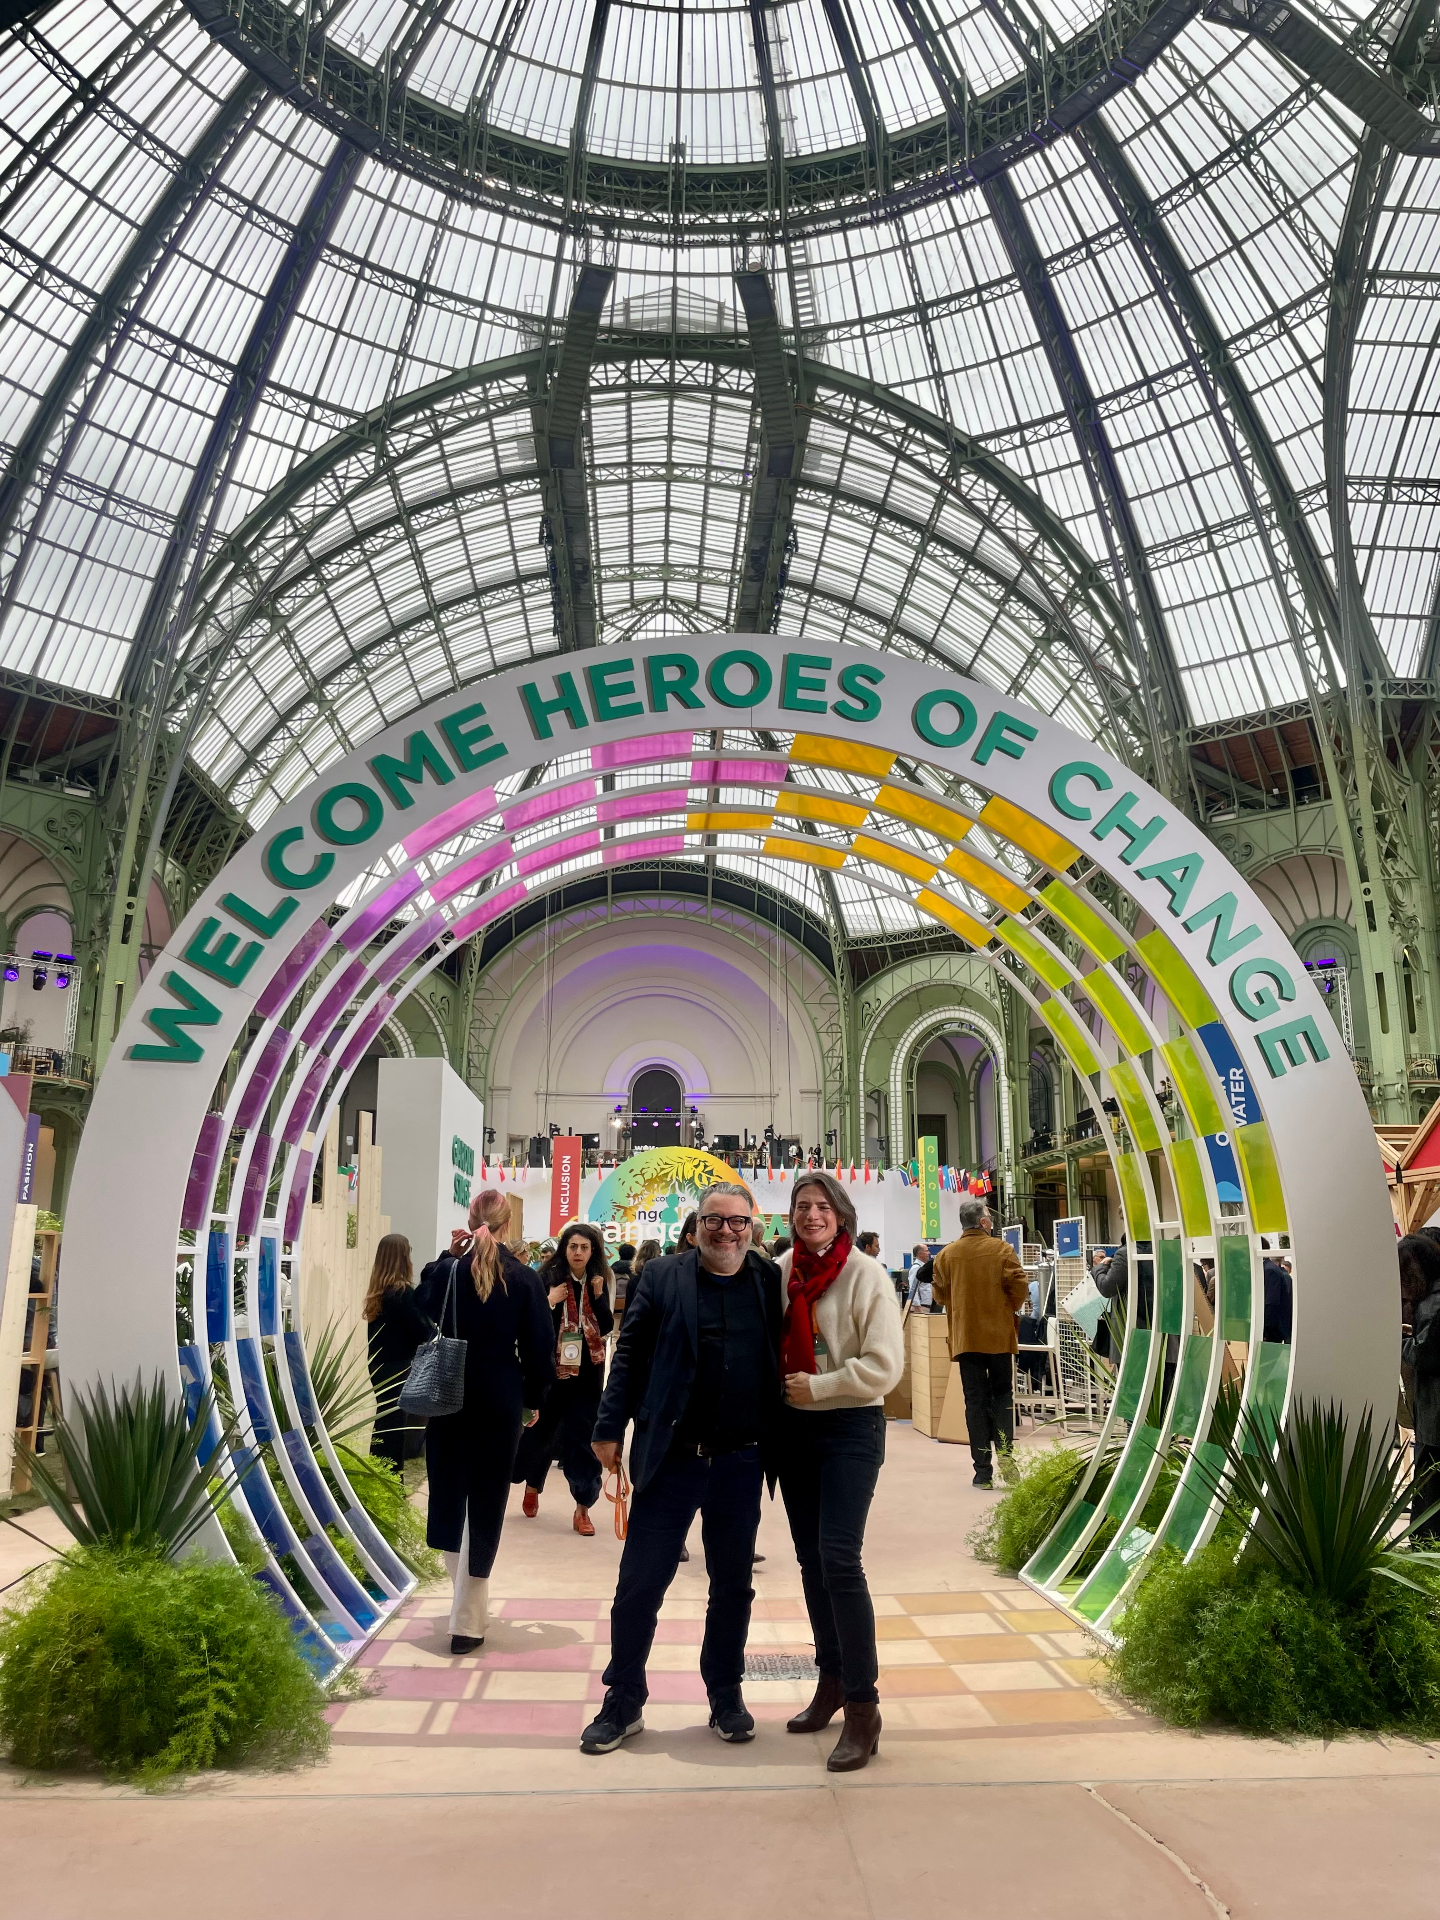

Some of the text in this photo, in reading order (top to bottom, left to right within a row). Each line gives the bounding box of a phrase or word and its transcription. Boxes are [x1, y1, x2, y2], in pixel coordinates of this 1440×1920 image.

[128, 648, 1331, 1080] WELCOME HEROES OF CHANGE
[22, 1142, 34, 1201] FASHION
[560, 1155, 571, 1216] INCLUSION
